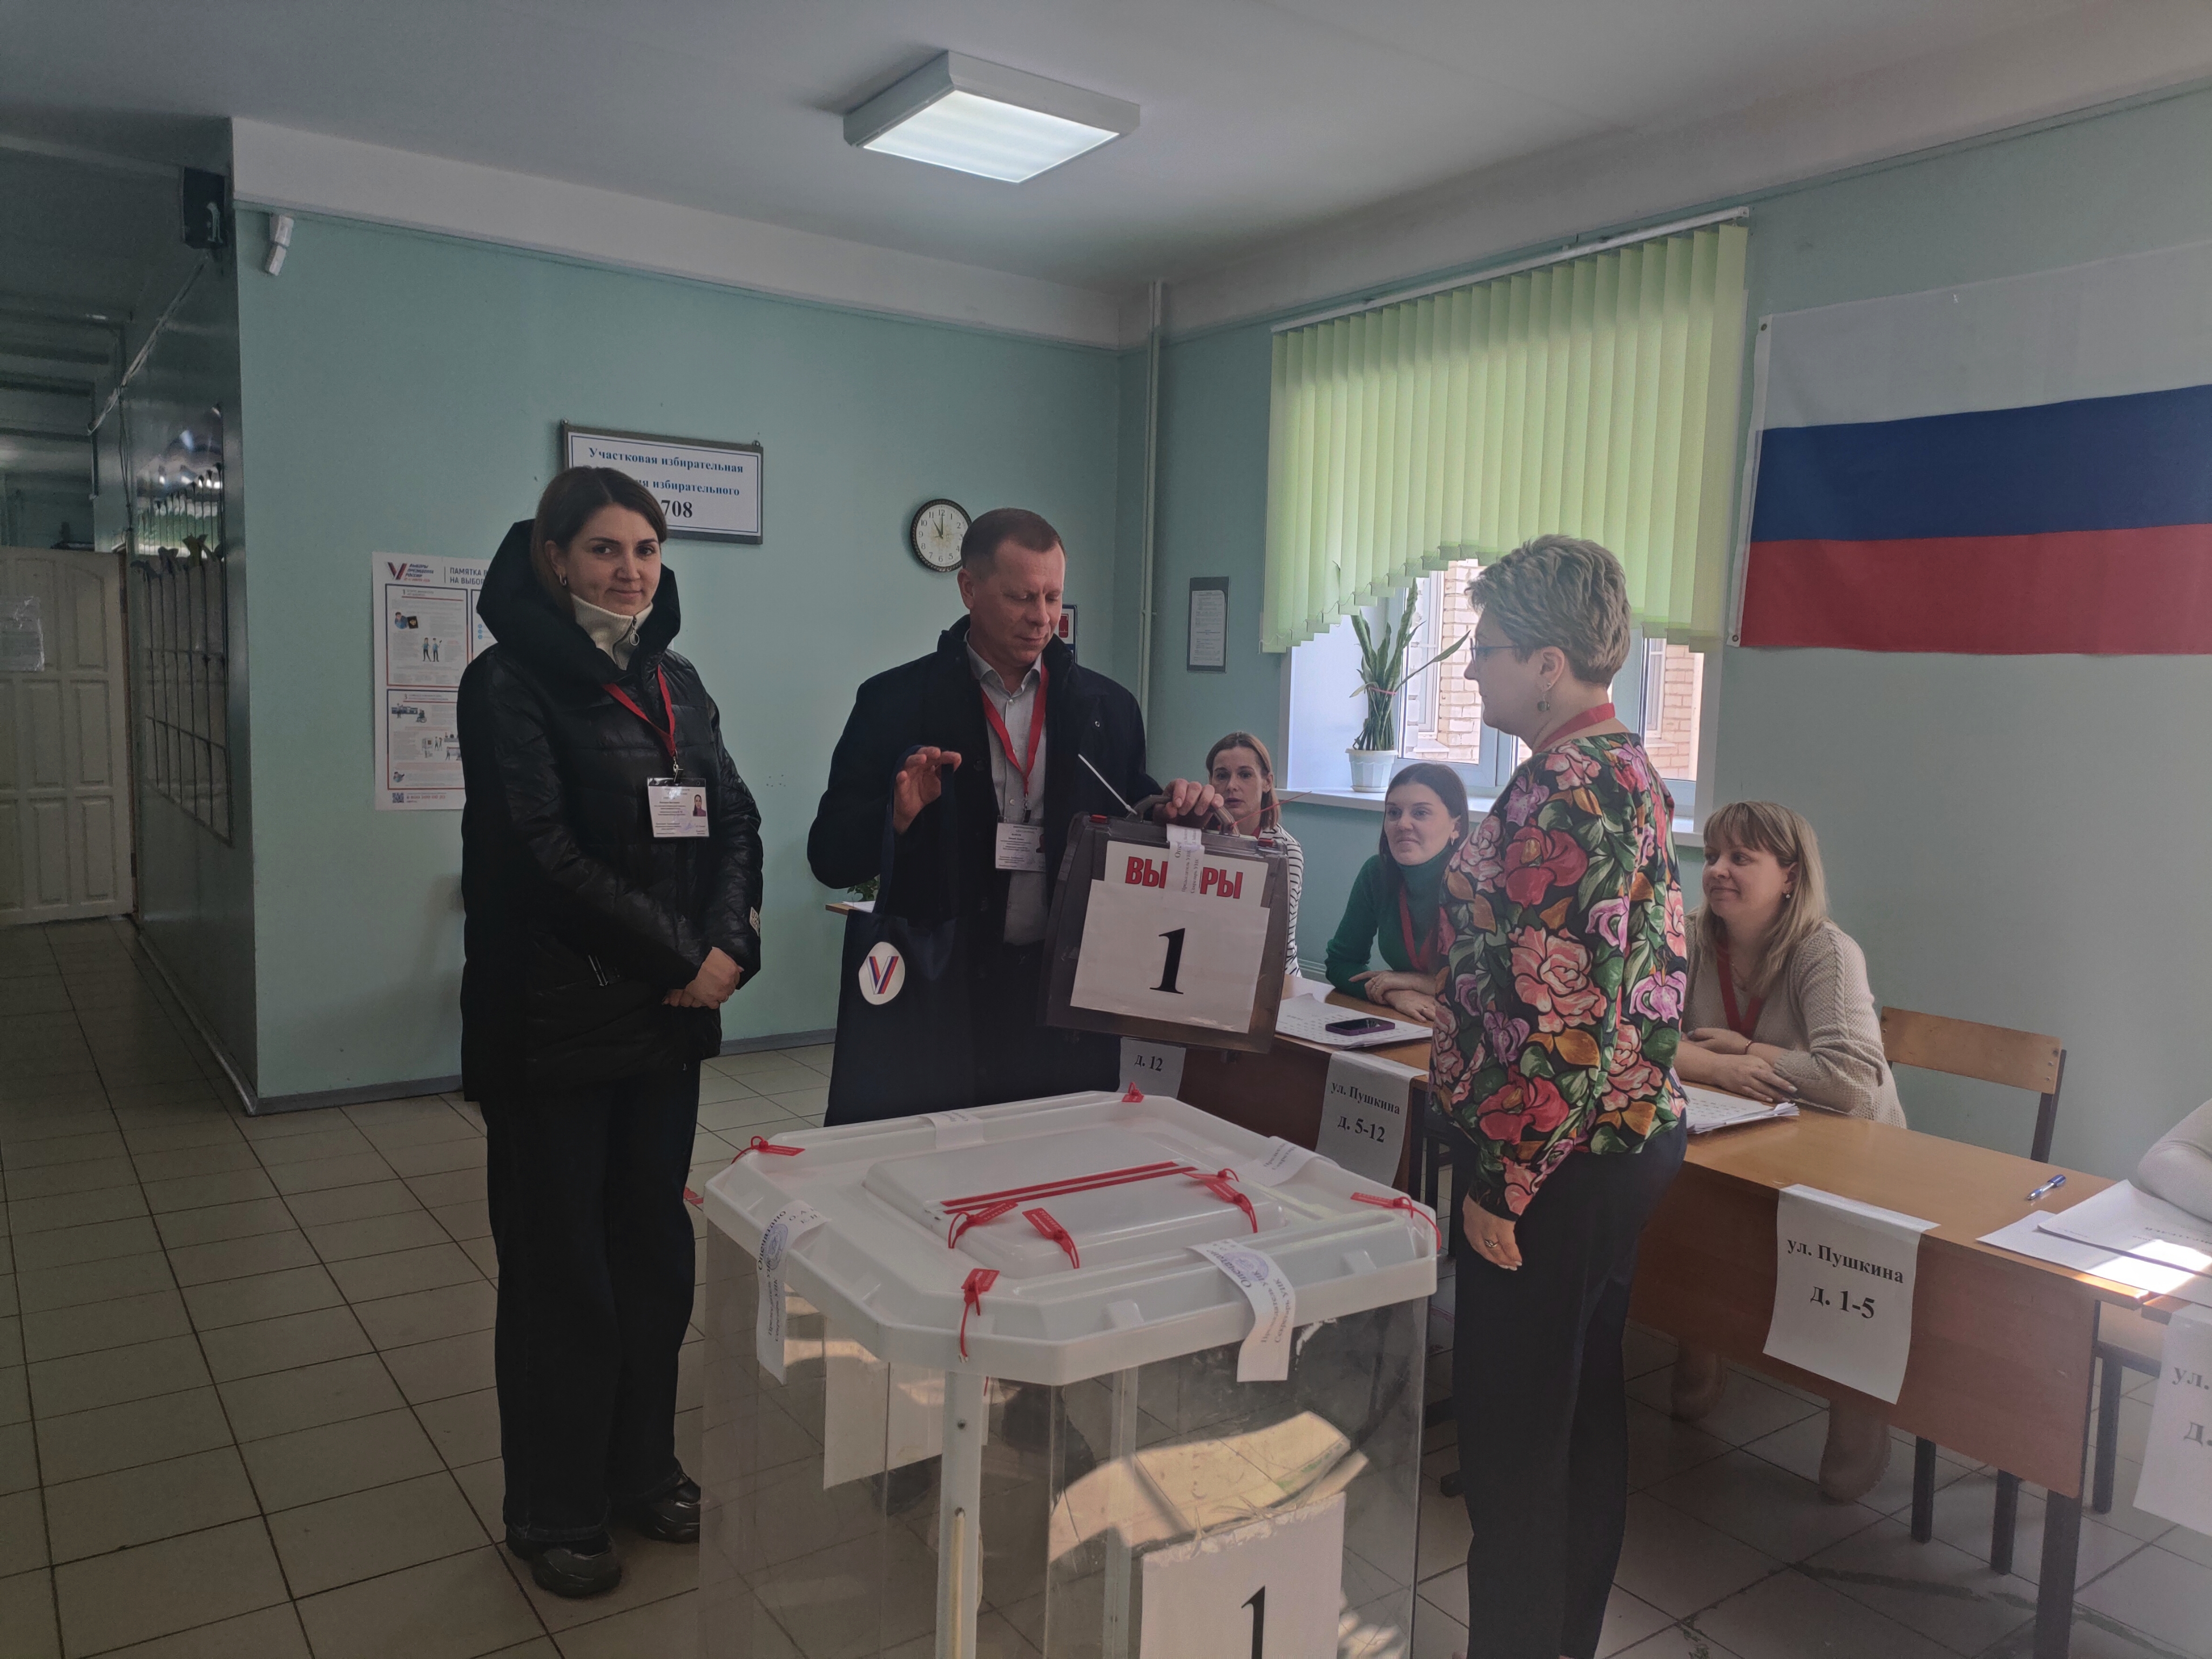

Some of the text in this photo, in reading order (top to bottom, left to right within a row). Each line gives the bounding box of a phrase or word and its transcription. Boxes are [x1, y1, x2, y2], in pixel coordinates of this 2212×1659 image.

[589, 447, 744, 474] Участковая избирательная
[652, 480, 740, 496] избирательного
[660, 500, 693, 518] 708
[450, 567, 482, 576] ПАМЯТКА
[1125, 856, 1243, 899] ВЫРЫ
[1149, 927, 1186, 995] 1
[1134, 1055, 1163, 1072] д. 12
[1331, 1082, 1400, 1115] ул. Пушкина
[1337, 1115, 1385, 1143] д. 5-12
[1786, 1239, 1904, 1284] ул. Пушкина
[1810, 1286, 1875, 1319] д. 1-5
[2171, 1366, 2209, 1390] ул.
[2183, 1421, 2212, 1448] д.
[1241, 1584, 1265, 1659] 1
